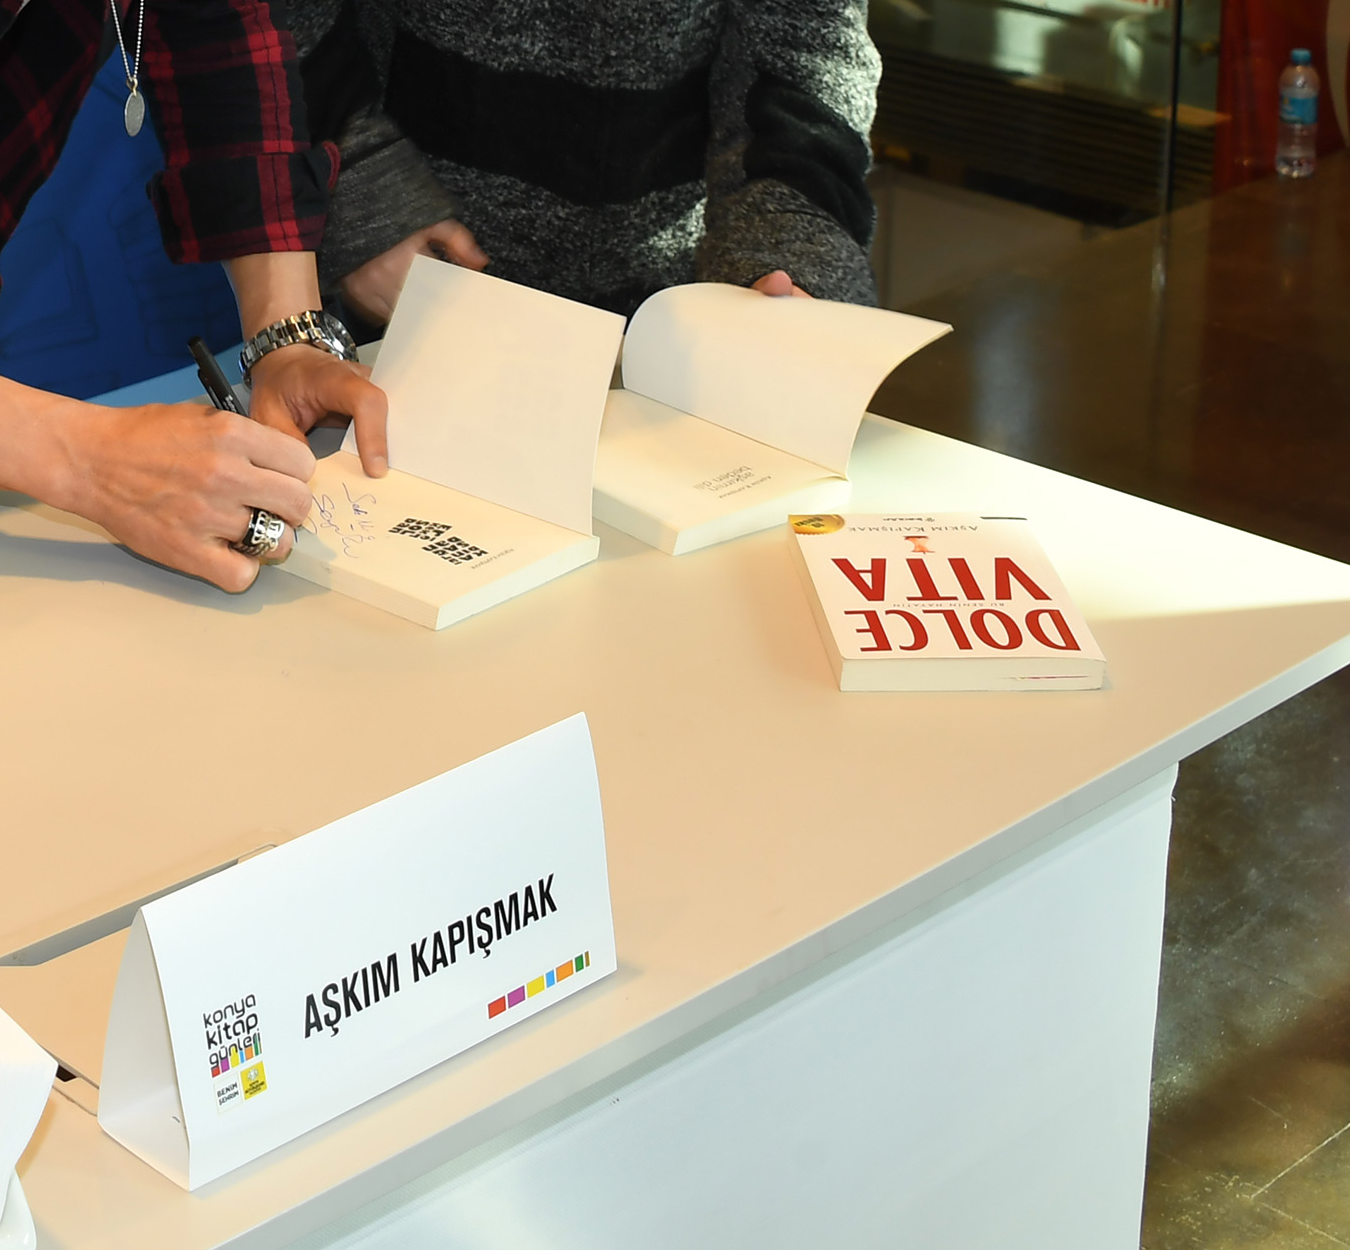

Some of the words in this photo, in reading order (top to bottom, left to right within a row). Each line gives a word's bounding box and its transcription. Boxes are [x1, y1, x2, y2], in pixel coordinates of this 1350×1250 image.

[830, 556, 1053, 602] VITA
[843, 608, 1082, 652] DOLCE
[304, 952, 400, 1039] AŞKIM
[410, 872, 558, 984] KAPIŞMAK
[203, 993, 257, 1029] konya
[205, 1013, 259, 1050] kitap
[208, 1028, 261, 1071] günleri
